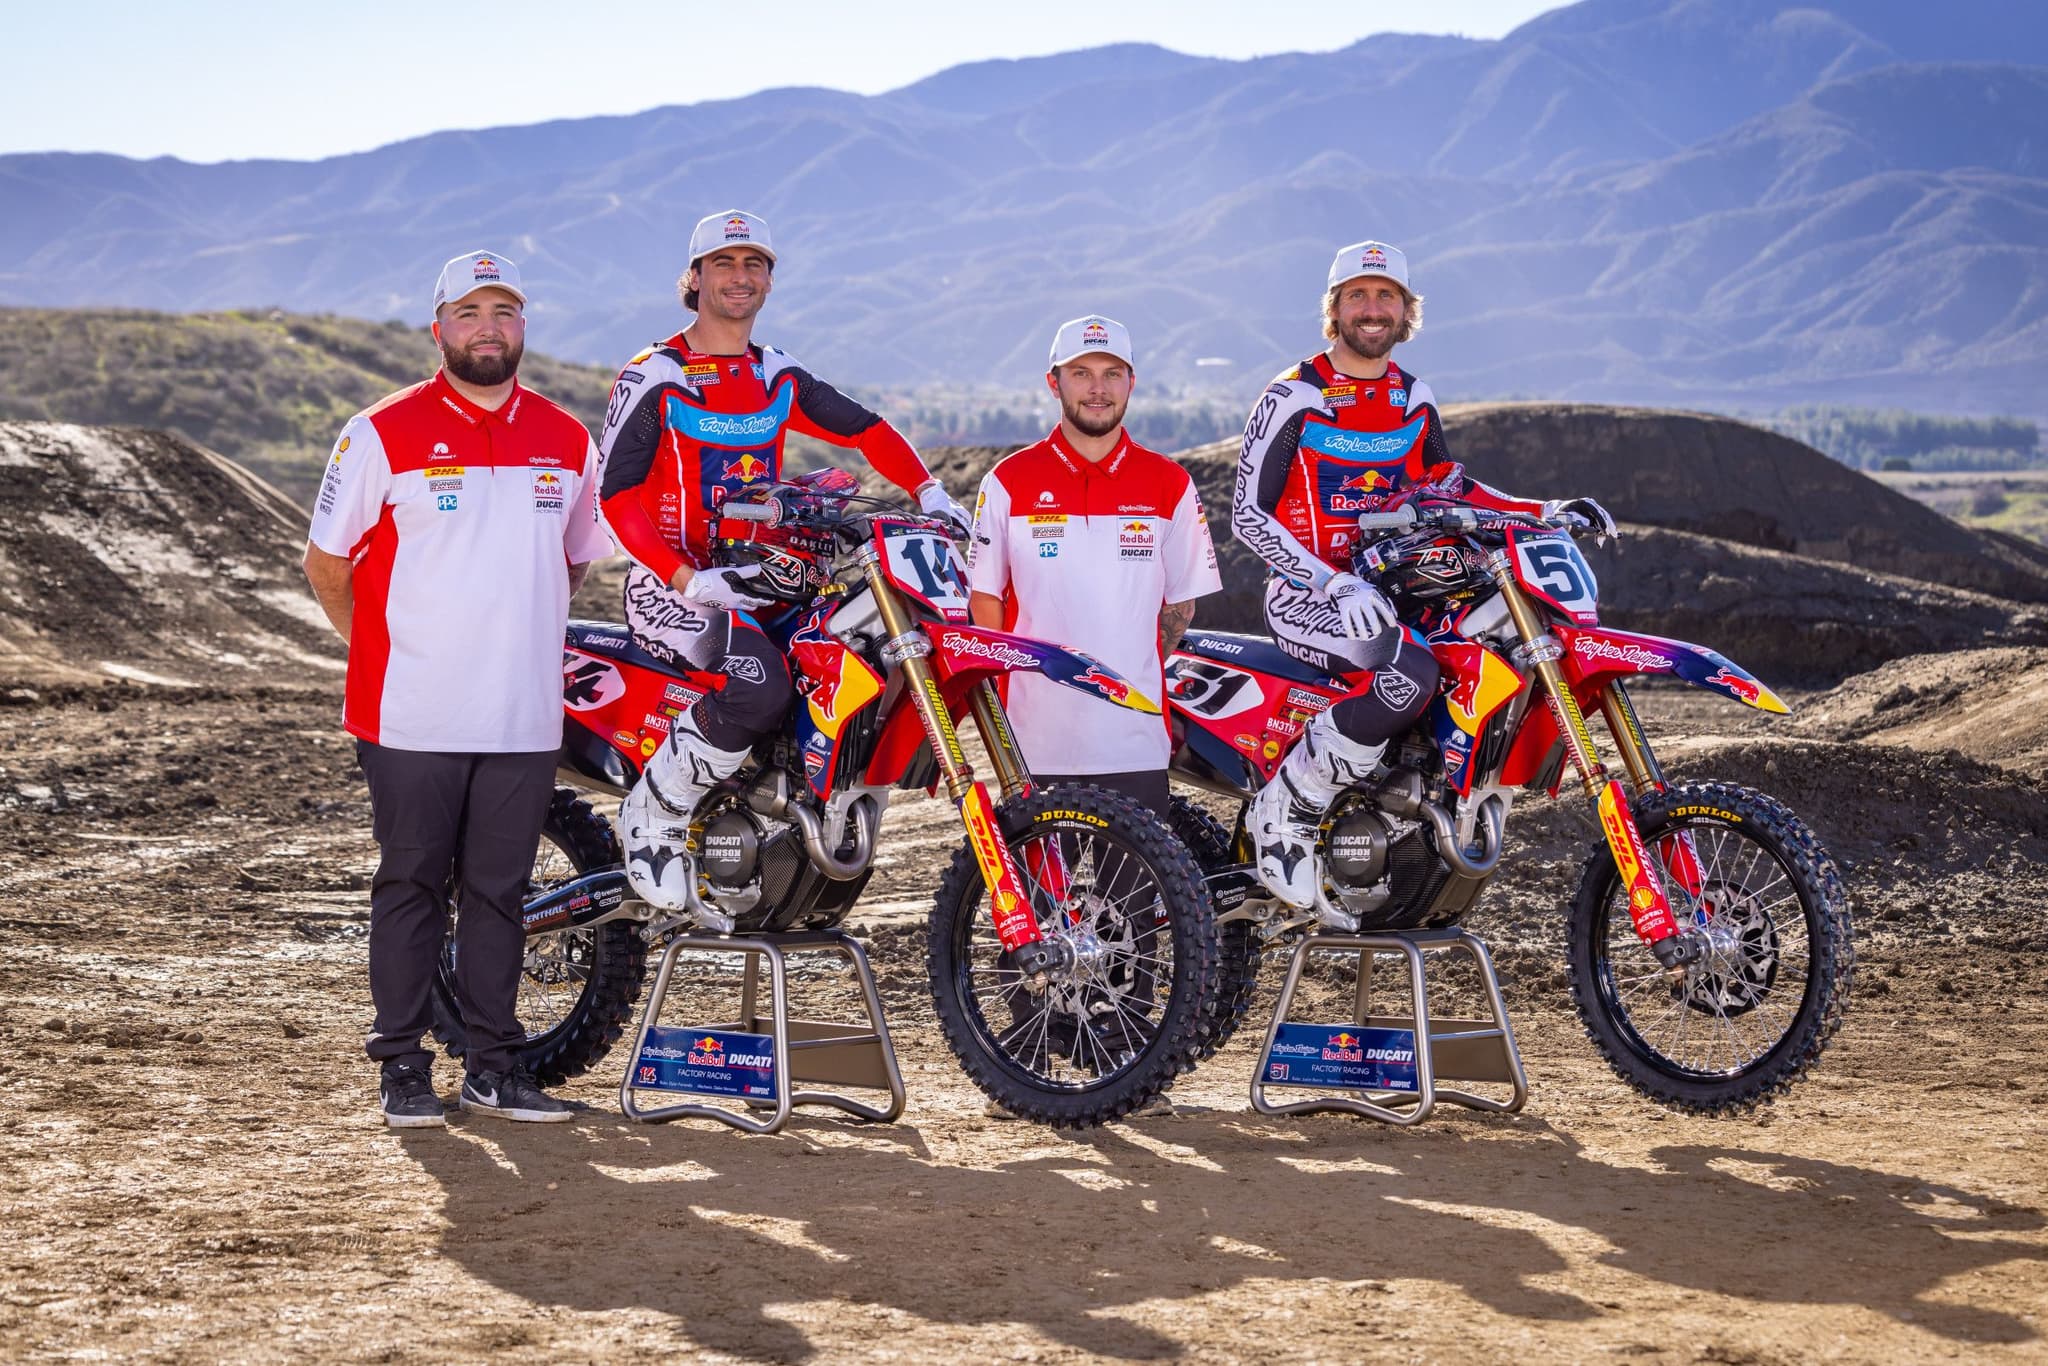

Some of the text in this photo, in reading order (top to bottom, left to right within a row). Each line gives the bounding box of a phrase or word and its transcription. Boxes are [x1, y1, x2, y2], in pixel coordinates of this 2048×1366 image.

[688, 365, 712, 373] DHL
[1327, 387, 1352, 396] DHL
[534, 485, 563, 496] Red Bull
[438, 496, 457, 510] PPG
[536, 500, 563, 509] DUCATI
[1331, 494, 1365, 511] Red
[1120, 534, 1154, 544] Red Bull
[1040, 543, 1058, 557] PPG
[1120, 549, 1153, 557] DUCATI
[901, 538, 969, 599] 14
[1523, 543, 1597, 602] 51
[583, 633, 628, 649] DUCATI
[942, 633, 970, 657] Troy
[966, 636, 990, 656] Lee
[1199, 638, 1244, 655] DUCATI
[1575, 636, 1602, 660] Troy
[1599, 640, 1622, 659] Lee
[1276, 636, 1329, 670] DUCATI
[674, 687, 704, 702] GANASS
[1266, 717, 1296, 735] BN3TH
[1041, 809, 1109, 828] DUNLOP
[1676, 806, 1743, 823] DUNLOP
[705, 836, 741, 846] DUCATI
[971, 814, 996, 875] DHL
[1333, 835, 1370, 845] DUCATI
[1604, 813, 1630, 870] DHL
[705, 849, 741, 857] HINSON
[991, 820, 1025, 900] DUNLOP
[1333, 848, 1371, 856] HINSON
[1626, 819, 1661, 897] DUNLOP
[523, 905, 566, 924] ENTHAL
[688, 1051, 726, 1067] Red Bull
[729, 1053, 772, 1068] DUCATI
[1322, 1047, 1363, 1063] Red Bull
[1365, 1048, 1413, 1062] DUCATI
[677, 1068, 732, 1081] FACTORY RACING
[1269, 1063, 1290, 1080] 51
[1311, 1063, 1370, 1076] FACTORY RACING
